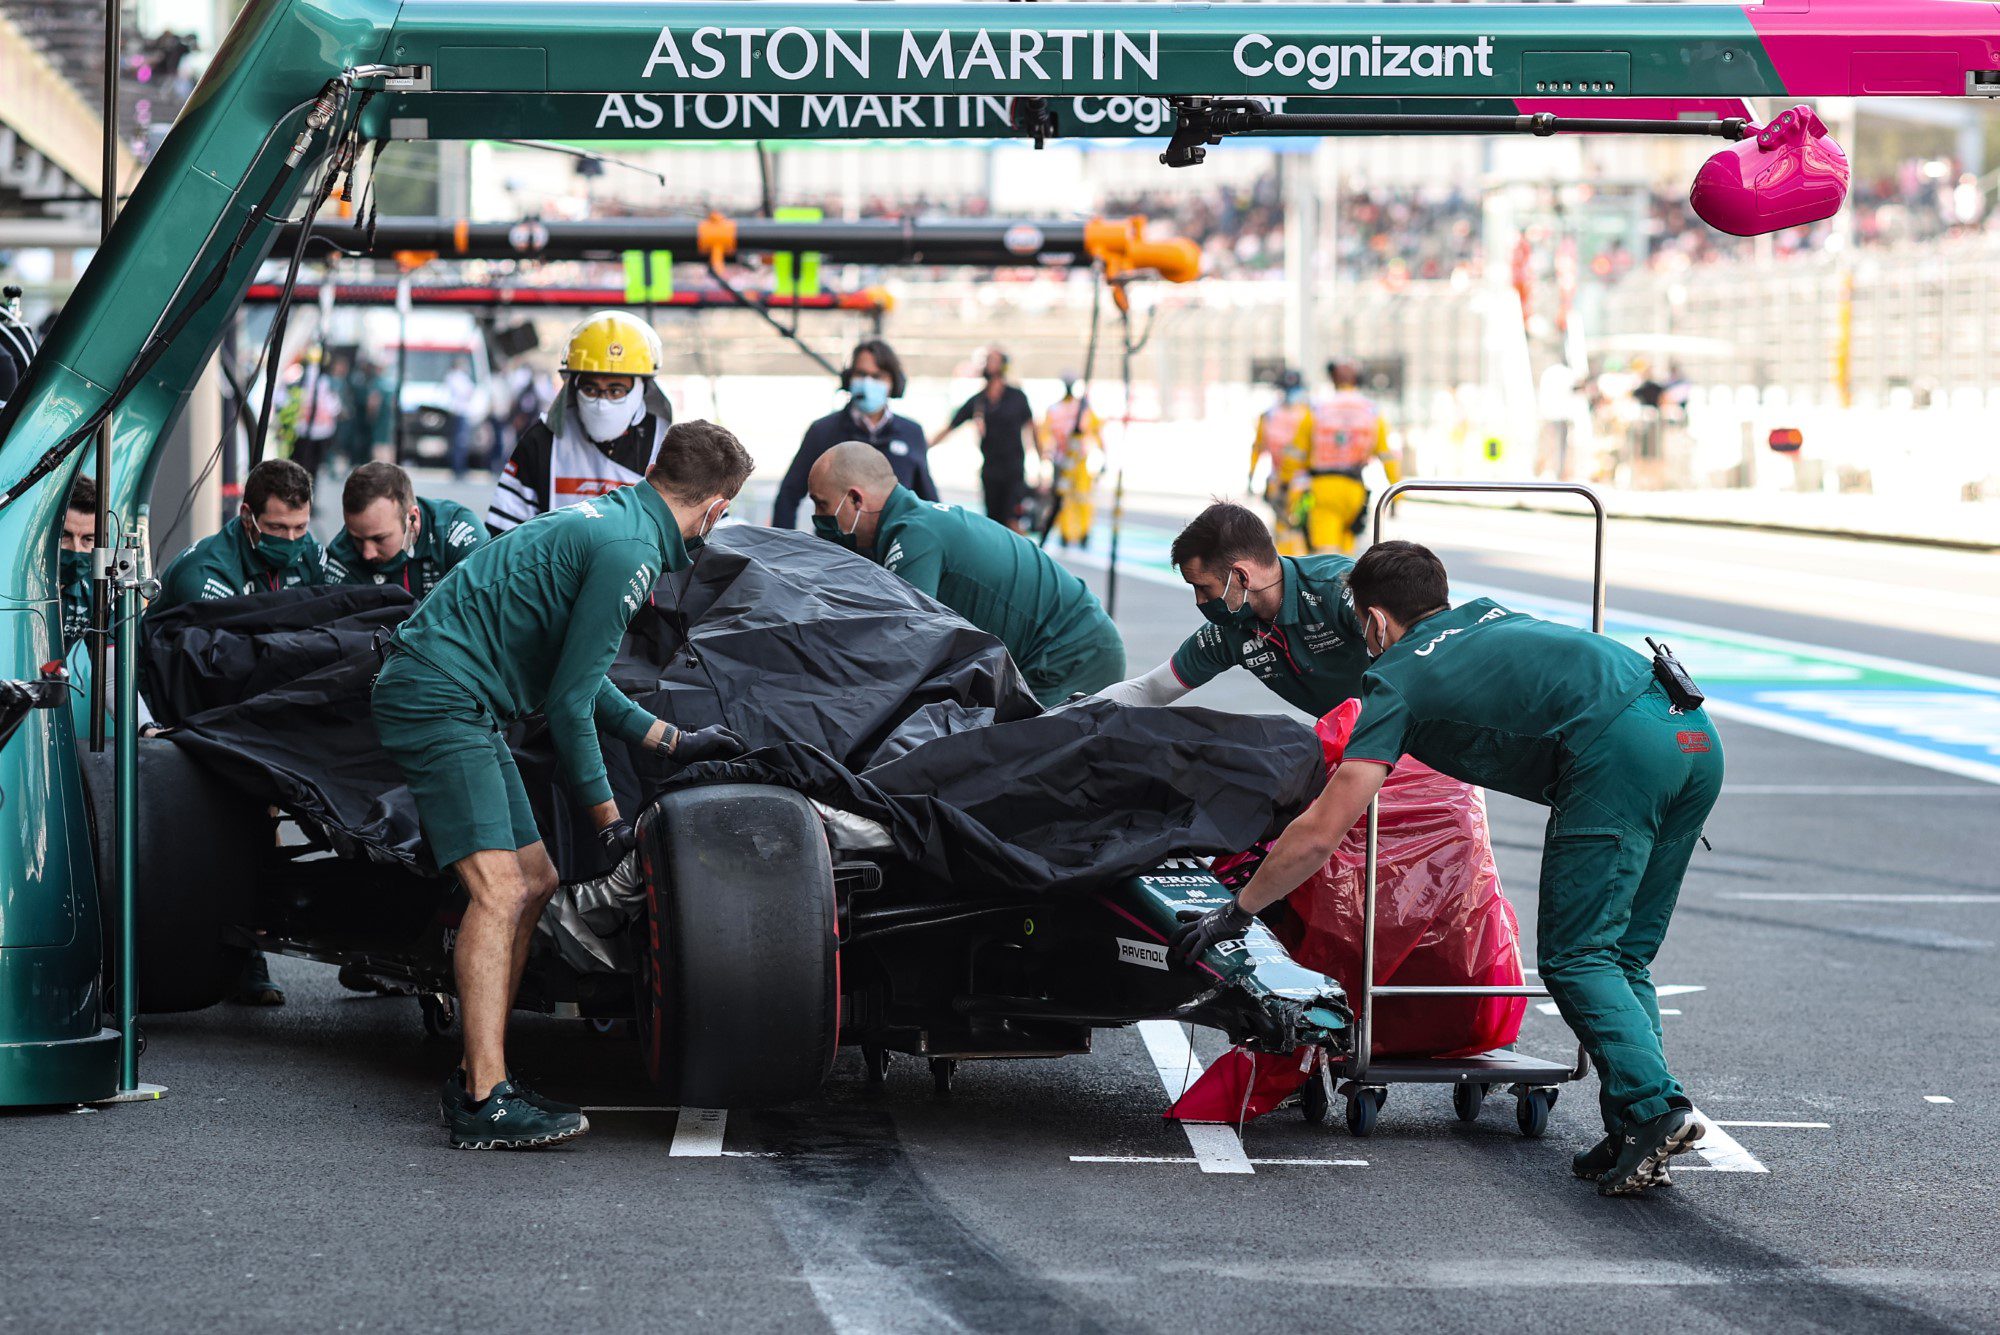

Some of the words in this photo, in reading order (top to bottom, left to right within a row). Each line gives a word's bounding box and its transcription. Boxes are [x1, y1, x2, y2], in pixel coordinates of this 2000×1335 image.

[641, 26, 870, 80] ASTON
[897, 28, 1158, 80] MARTIN
[1233, 33, 1493, 90] Cognizant
[1139, 876, 1220, 885] PERONI
[1121, 944, 1164, 963] RAVENOL
